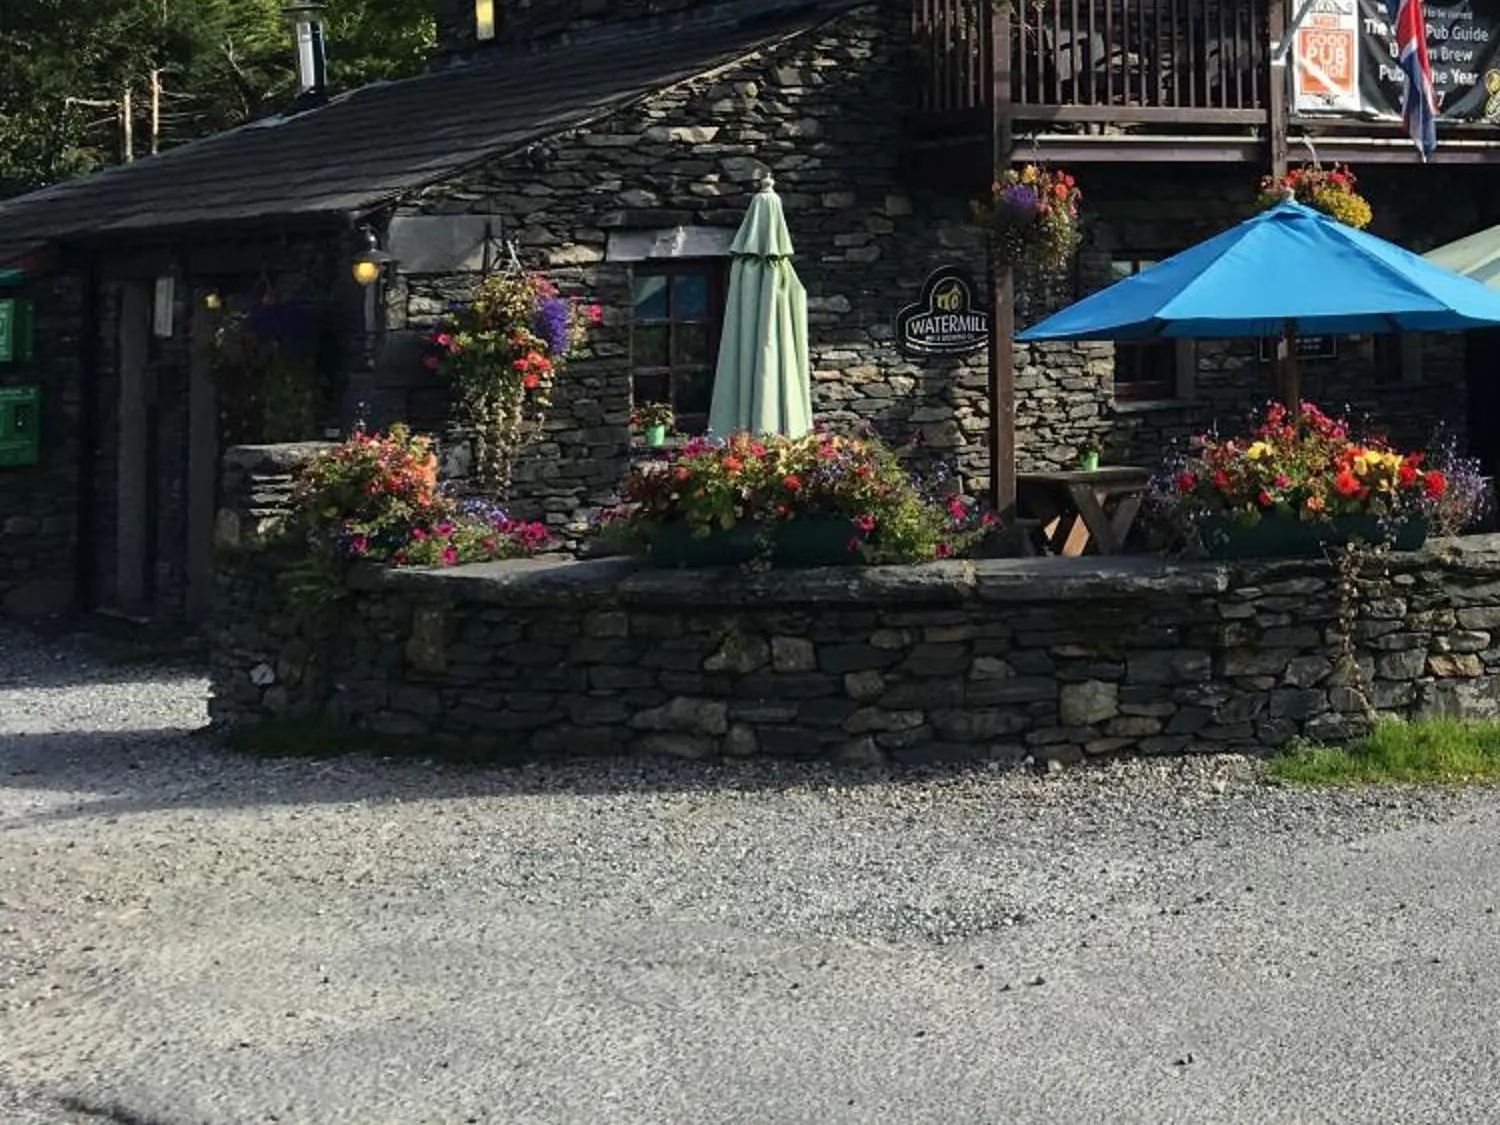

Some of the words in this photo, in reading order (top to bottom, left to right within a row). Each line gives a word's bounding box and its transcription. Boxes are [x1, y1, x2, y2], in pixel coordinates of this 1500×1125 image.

[1363, 18, 1388, 36] The
[1425, 24, 1449, 40] Pub
[1452, 26, 1489, 42] Guide
[1306, 32, 1348, 48] GOOD
[1306, 47, 1346, 65] PUB
[1441, 46, 1473, 62] Brew
[1379, 64, 1405, 82] Pub
[1450, 68, 1478, 85] Year
[911, 315, 989, 335] WATERMILL
